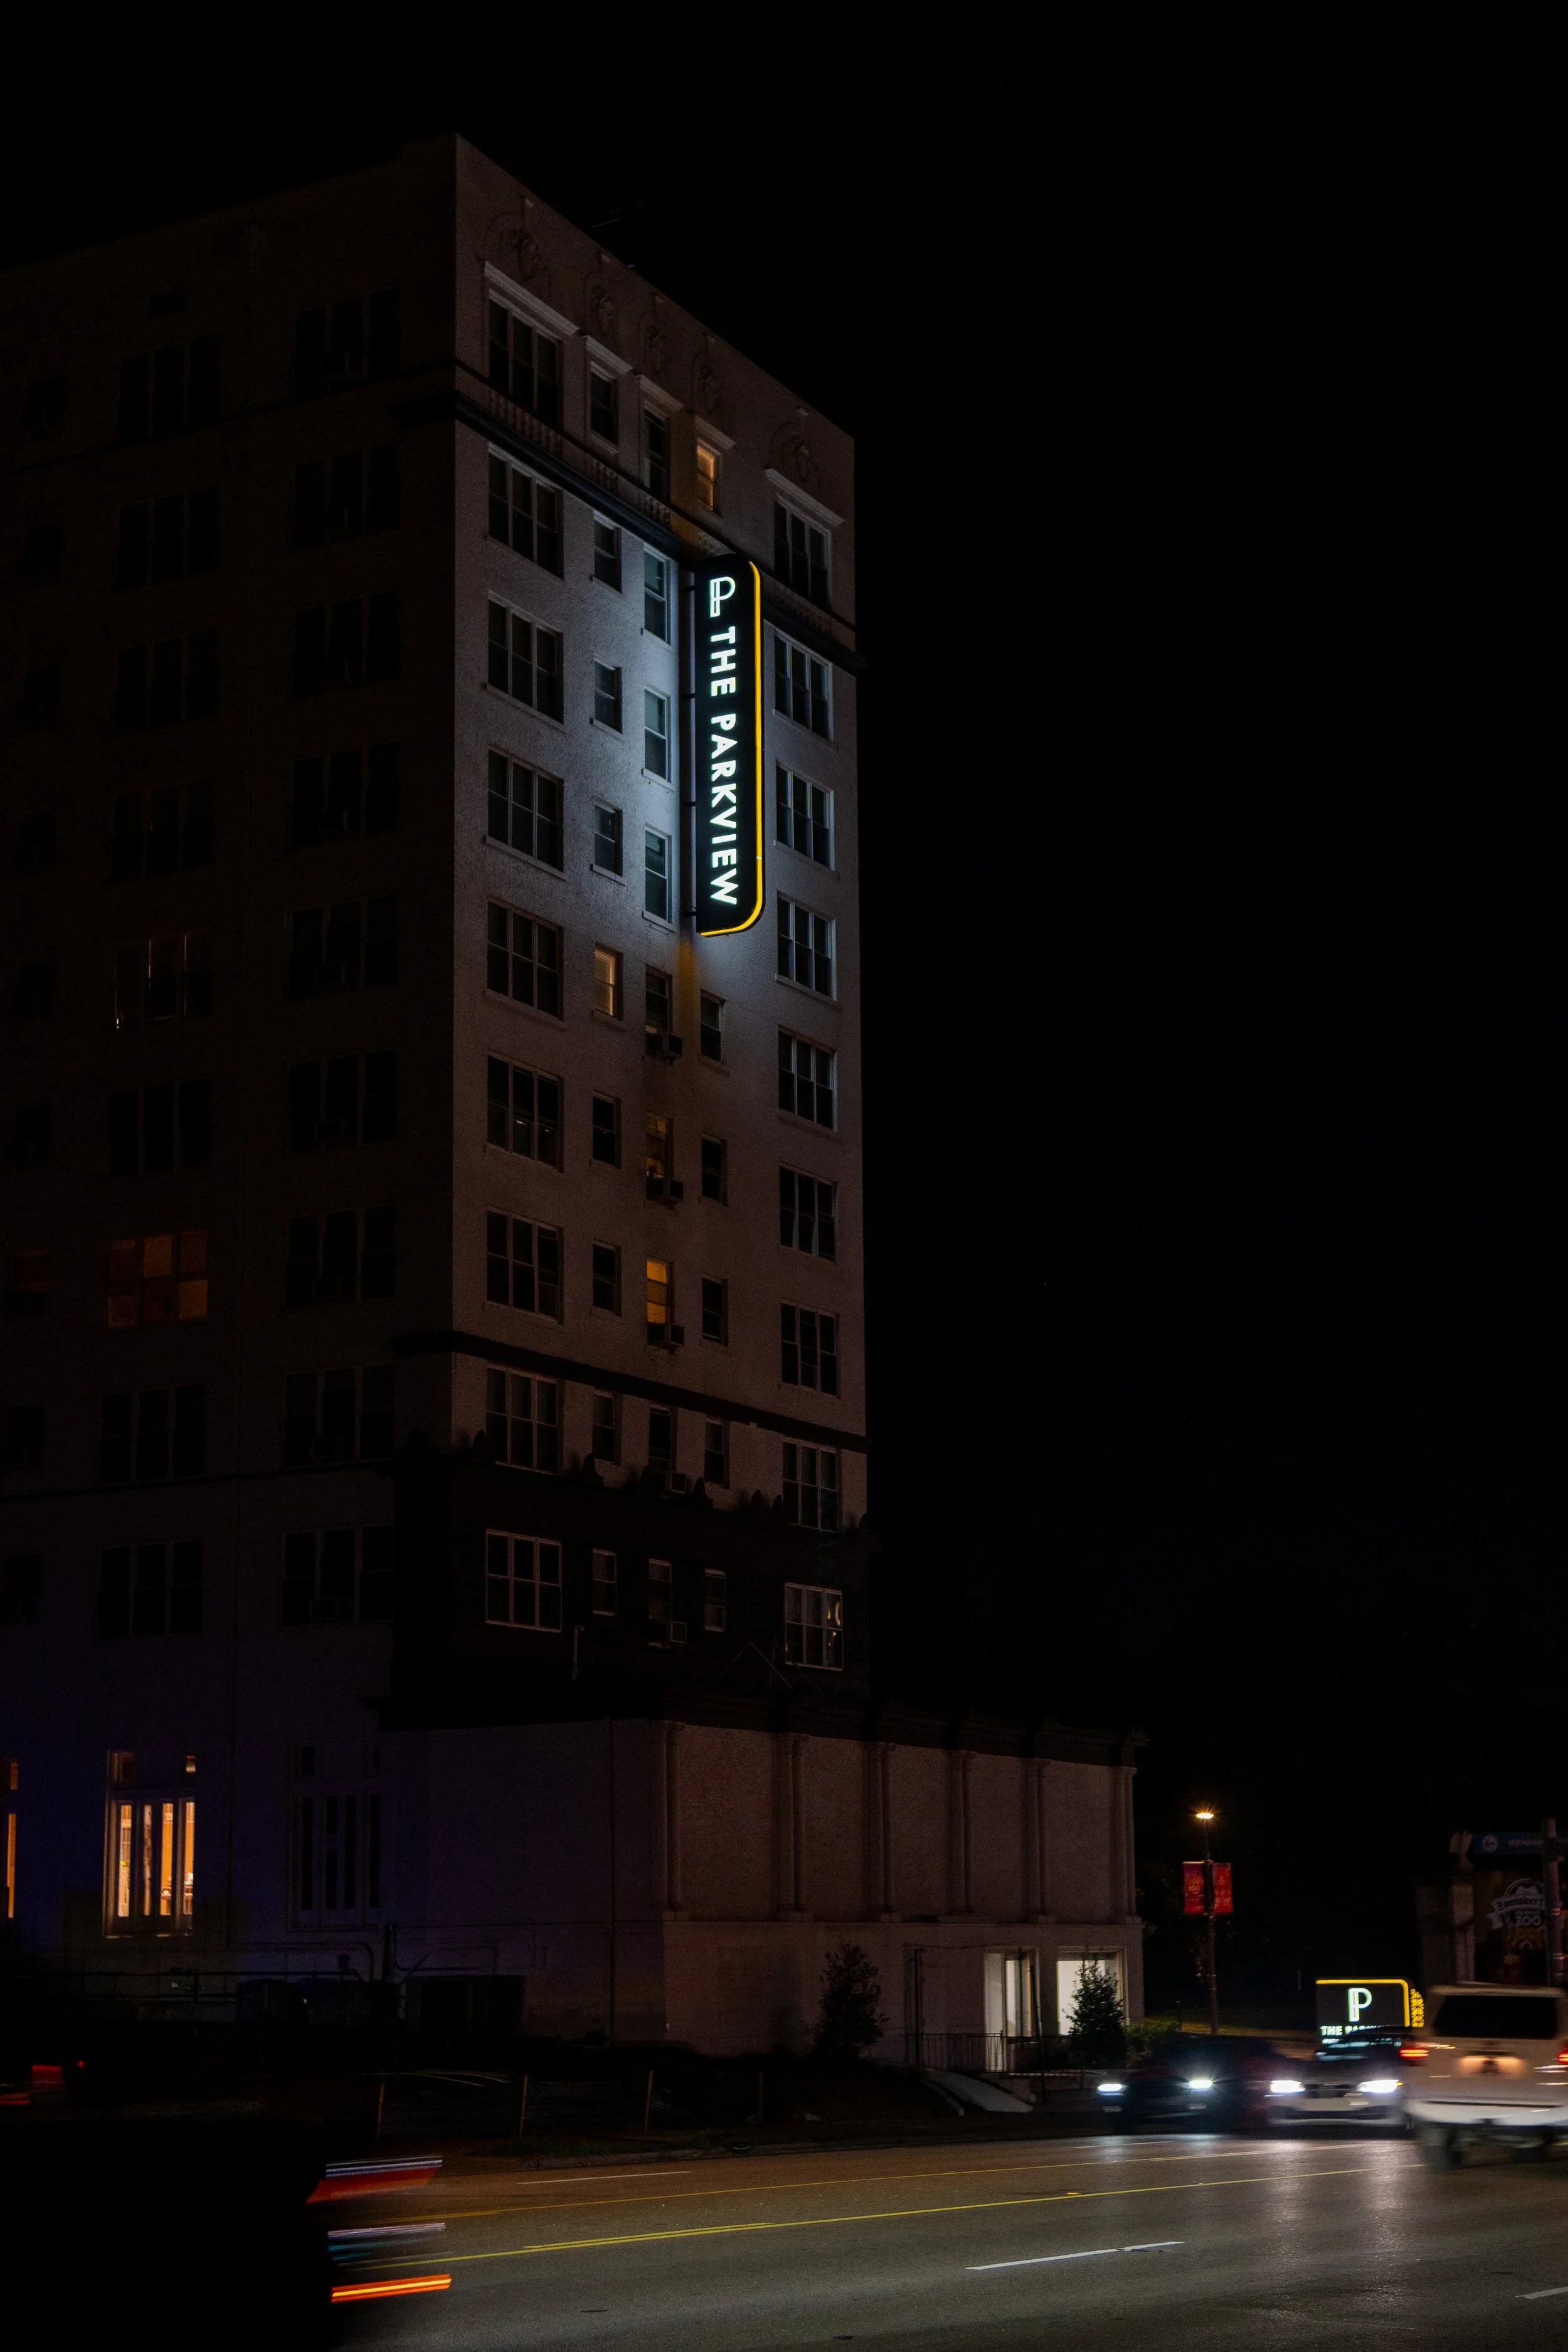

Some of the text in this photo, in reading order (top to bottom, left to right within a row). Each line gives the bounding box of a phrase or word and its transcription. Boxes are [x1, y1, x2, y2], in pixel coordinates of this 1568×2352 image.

[709, 575, 736, 618] P
[709, 625, 738, 905] THE PARKVIEW
[1348, 1987, 1372, 2022] P
[1320, 2025, 1343, 2036] THE
